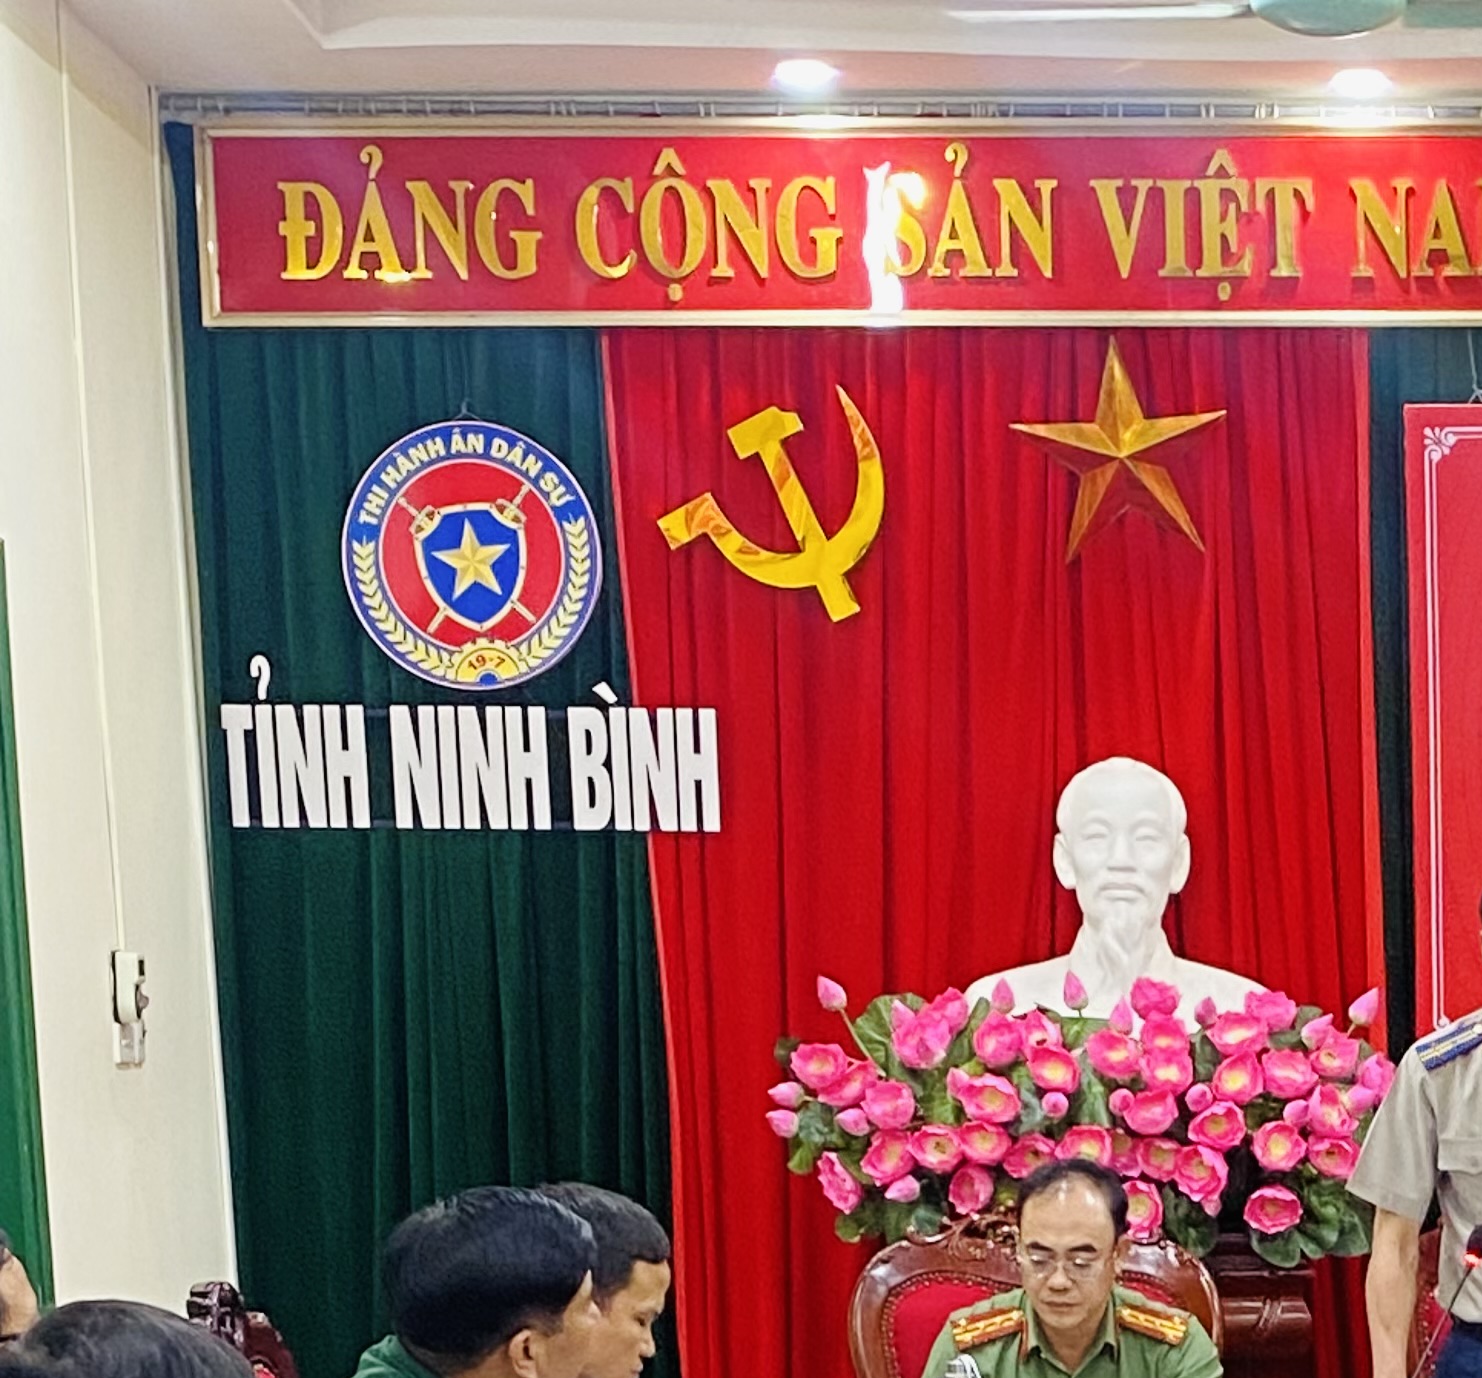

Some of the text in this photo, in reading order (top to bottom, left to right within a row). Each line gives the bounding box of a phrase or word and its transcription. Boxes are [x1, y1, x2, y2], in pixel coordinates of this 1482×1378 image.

[277, 144, 544, 281] ĐẢNG
[575, 147, 843, 302] CỘNG
[885, 142, 1059, 278] SẢN
[1089, 148, 1315, 302] VIỆT
[358, 484, 390, 525] THI
[381, 436, 446, 489] HÀNH
[490, 436, 543, 479] DÂN
[220, 655, 721, 832] TỈNH NINH BÌNH
